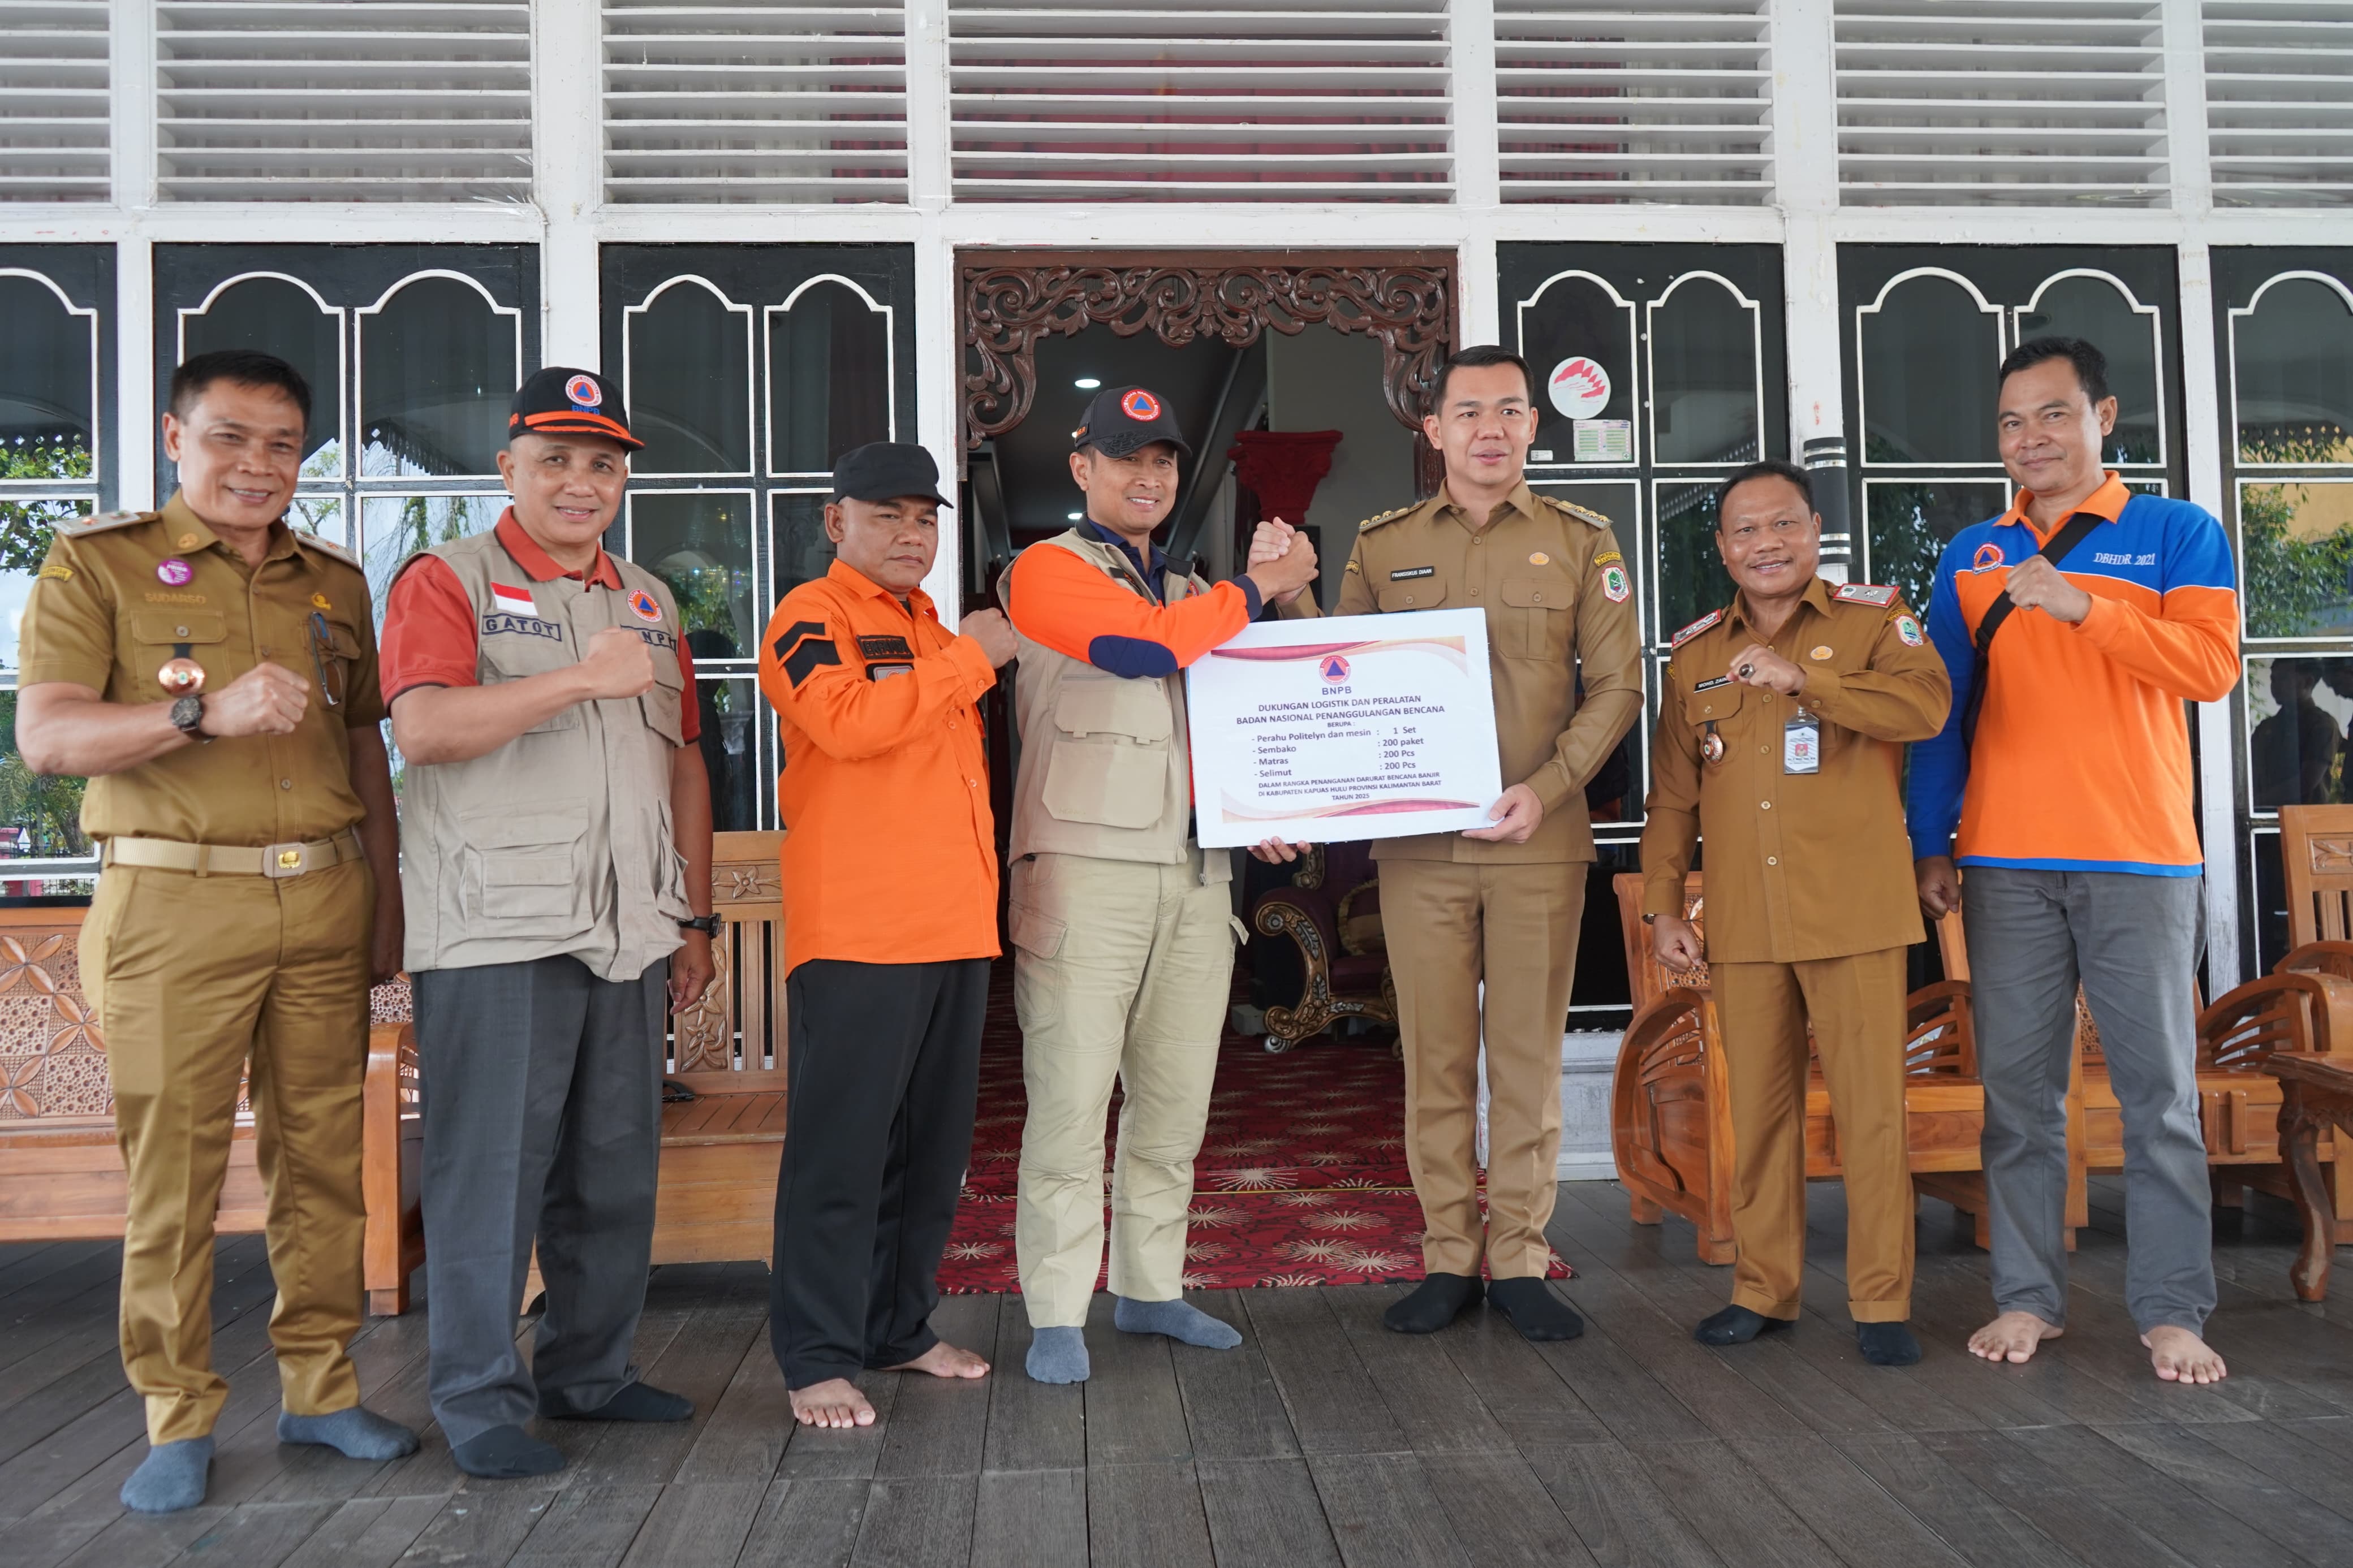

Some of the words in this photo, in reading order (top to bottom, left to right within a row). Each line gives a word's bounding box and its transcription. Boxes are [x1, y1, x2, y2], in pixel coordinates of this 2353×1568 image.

[572, 404, 600, 416] BNPB
[2093, 552, 2132, 564] DBHDR
[2134, 553, 2155, 565] 2021
[145, 593, 206, 603] SUDARSO
[486, 617, 553, 636] GATOT
[1322, 686, 1351, 695] BNPB
[1259, 702, 1308, 711] DUKUNGAN
[1312, 700, 1349, 709] LOGISTIK
[1373, 696, 1421, 705] PERALATAN
[1270, 714, 1313, 722] NASIONAL
[1316, 709, 1401, 719] PENANGGULANGAN
[1403, 706, 1445, 714] BENCANA
[1289, 732, 1325, 740] Politelyn
[1258, 745, 1296, 754] Sembako
[1400, 738, 1424, 746] paket
